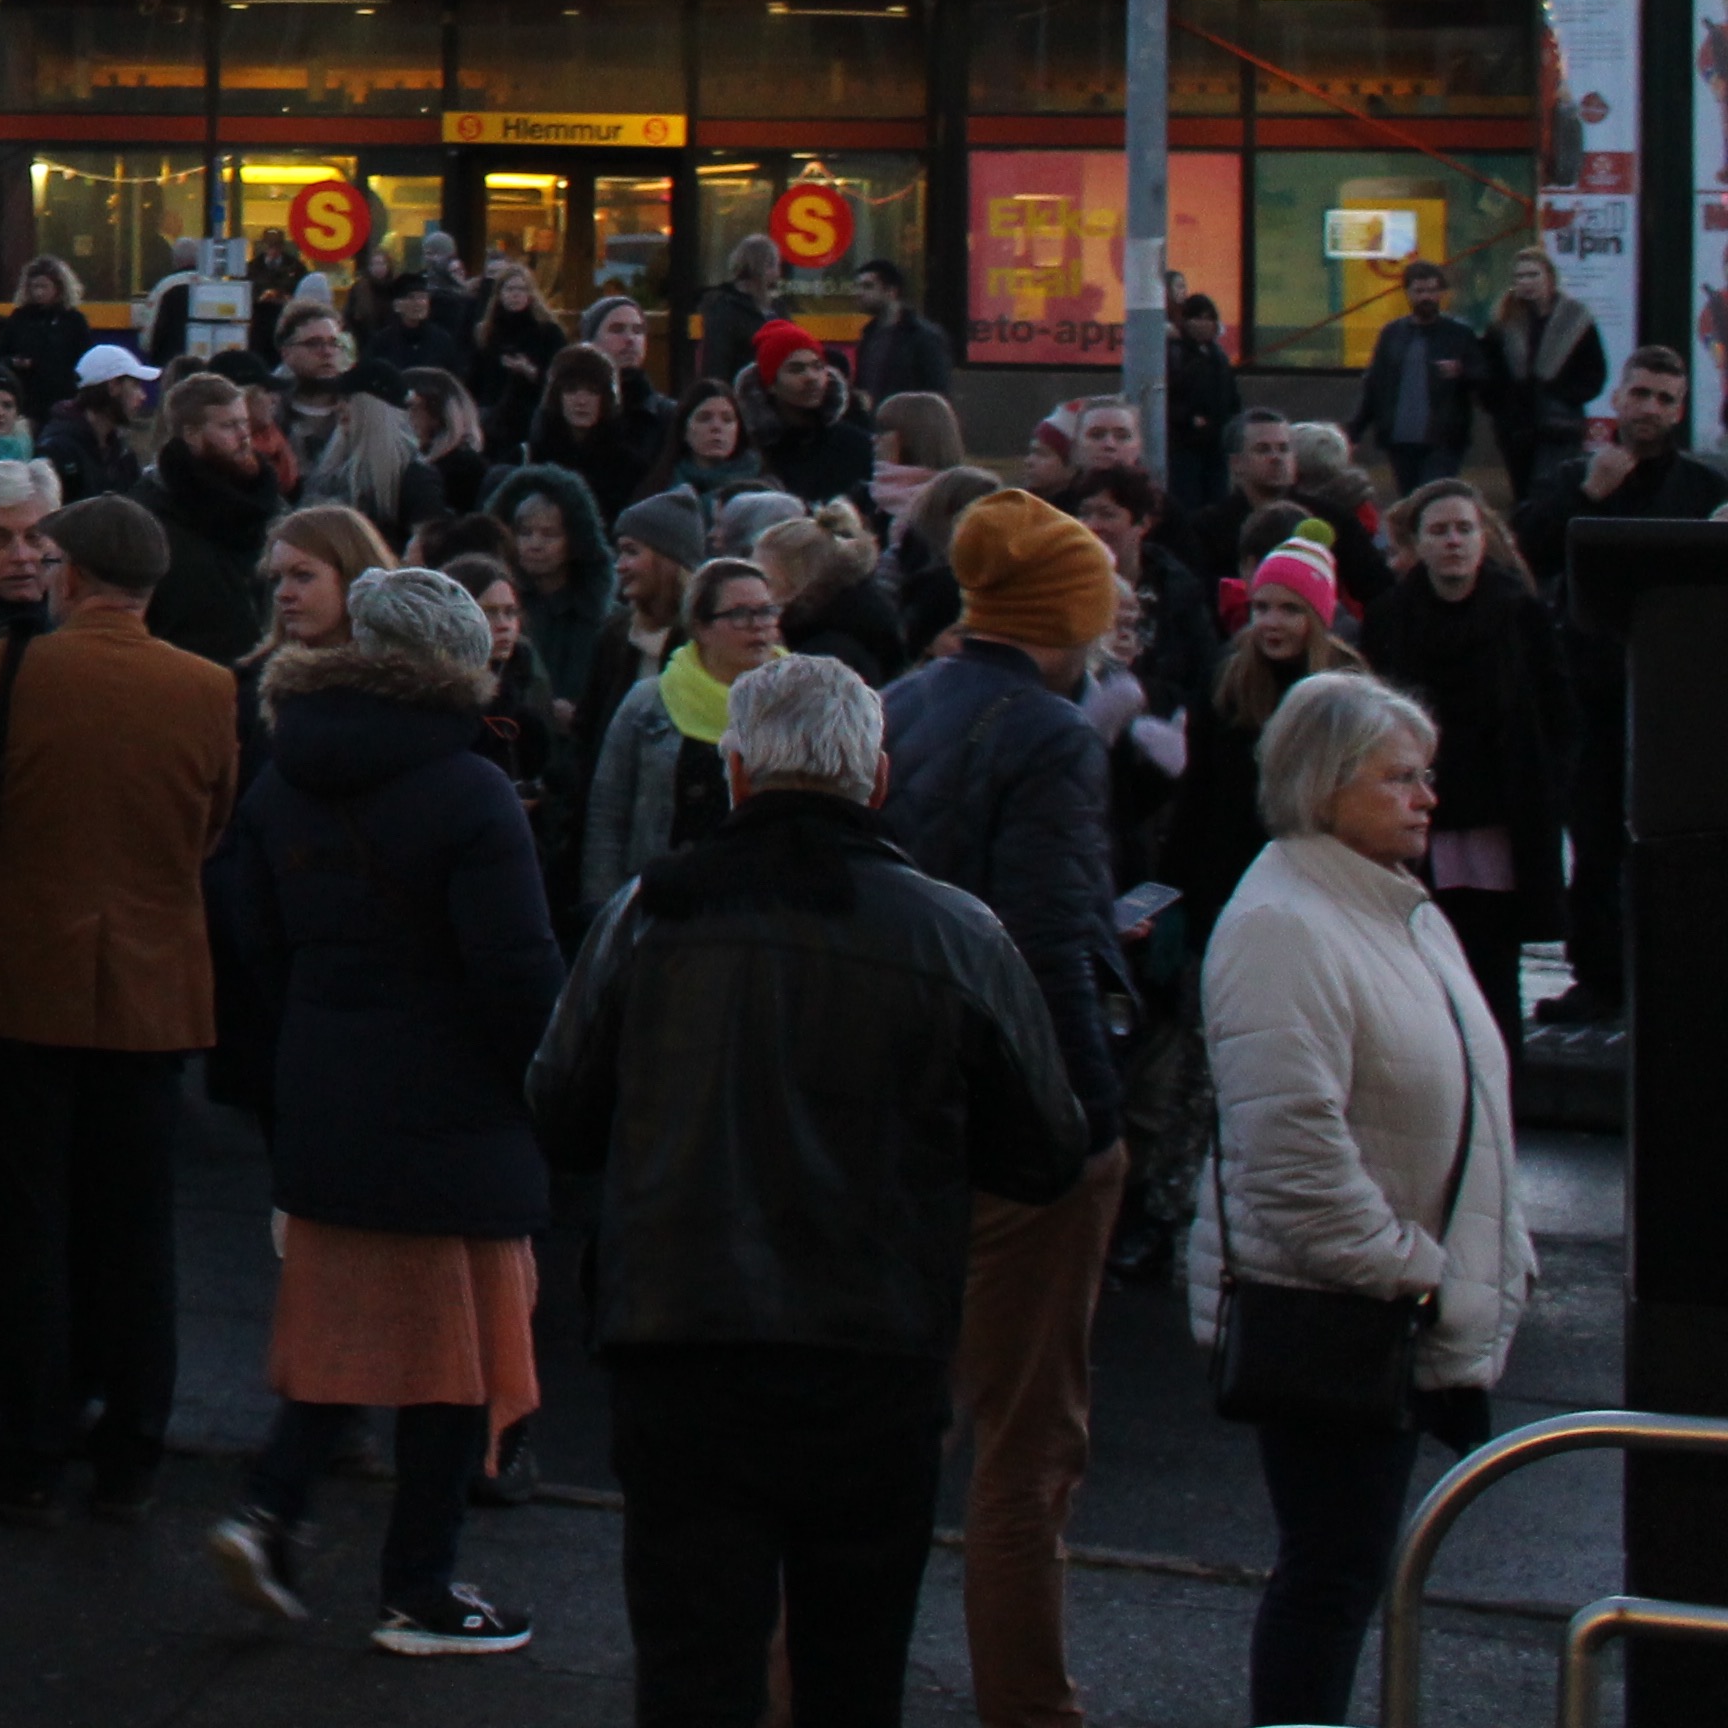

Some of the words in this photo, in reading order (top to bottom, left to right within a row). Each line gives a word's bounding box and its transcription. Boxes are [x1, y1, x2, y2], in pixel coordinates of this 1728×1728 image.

[502, 118, 622, 139] Hlemmur
[304, 191, 352, 251] S
[786, 195, 837, 256] S
